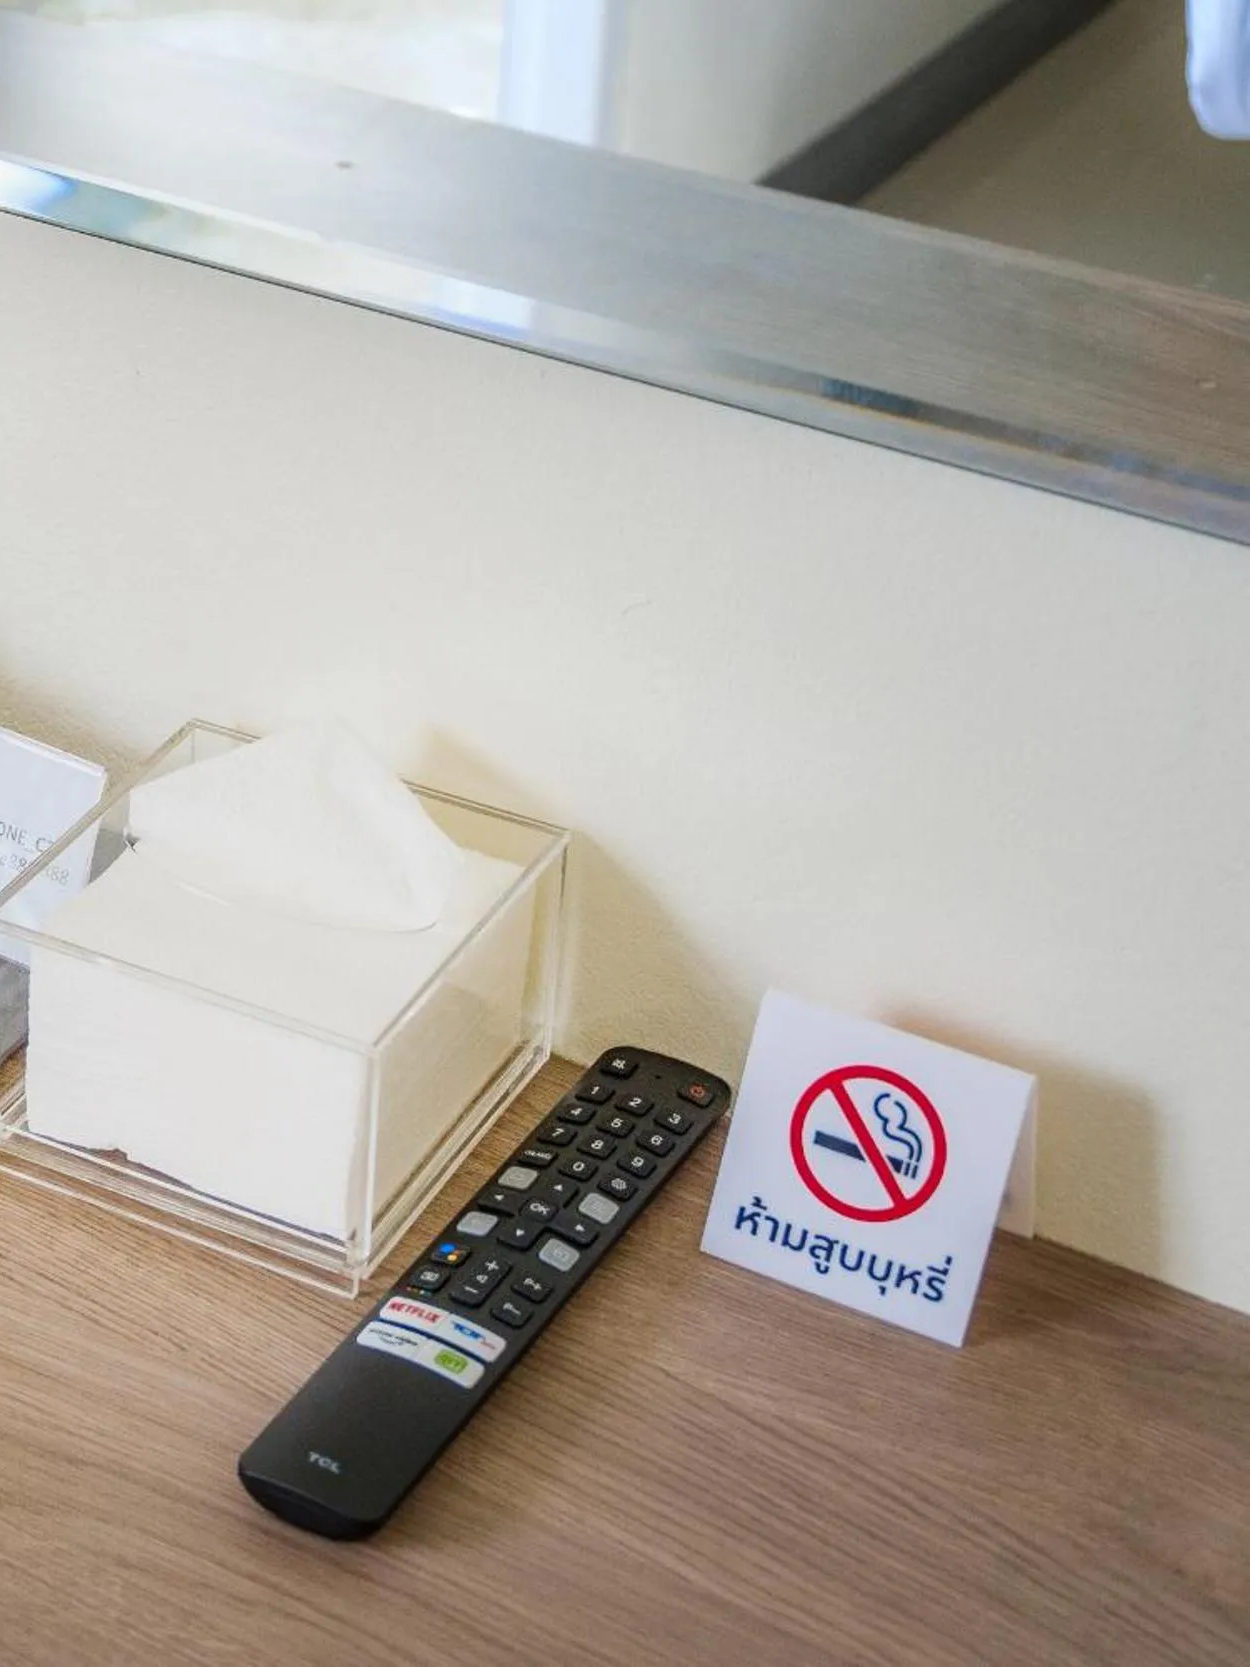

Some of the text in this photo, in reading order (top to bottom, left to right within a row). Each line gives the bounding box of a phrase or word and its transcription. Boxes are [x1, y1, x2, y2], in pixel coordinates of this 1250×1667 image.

[591, 1086, 600, 1095] 1
[629, 1096, 642, 1108] 2
[667, 1113, 681, 1124] 3
[551, 1127, 565, 1137] 7
[591, 1140, 604, 1150] 8
[631, 1156, 644, 1168] 9
[530, 1202, 550, 1216] OK
[734, 1196, 953, 1303] ห้ามสูบบุหรี่
[389, 1301, 441, 1324] NETFLIX
[309, 1451, 340, 1475] TCL
